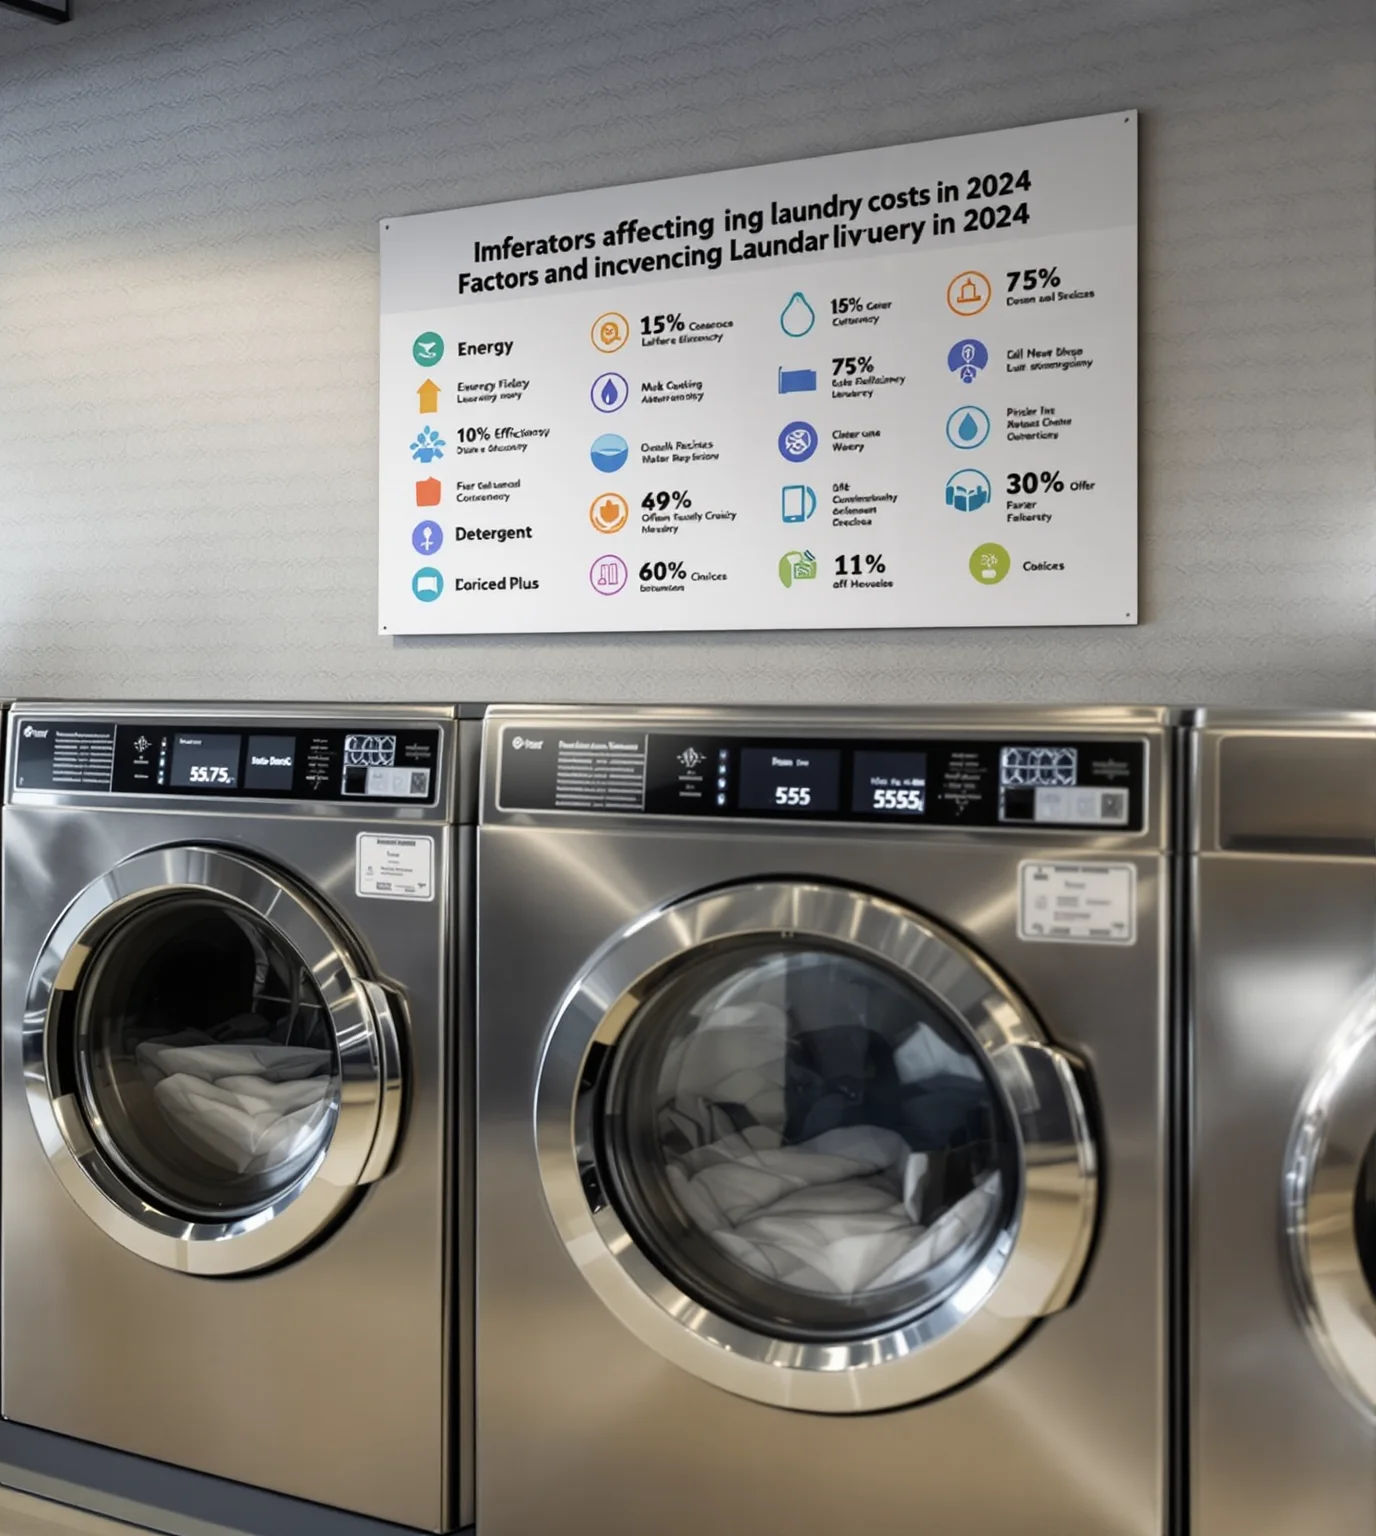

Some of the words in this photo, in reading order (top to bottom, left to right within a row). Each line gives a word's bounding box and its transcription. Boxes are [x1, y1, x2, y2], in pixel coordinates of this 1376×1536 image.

[474, 232, 595, 263] Imferators
[603, 216, 714, 247] affecting
[724, 208, 764, 234] ing
[771, 194, 863, 225] laundry
[868, 186, 930, 212] costs
[937, 181, 959, 203] in
[967, 169, 1031, 200] 2024
[458, 269, 539, 294] Factors
[544, 257, 588, 284] and
[595, 246, 722, 279] incvencing
[730, 229, 830, 262] Laundar
[933, 213, 956, 235] in
[963, 202, 1030, 232] 2024
[1006, 266, 1061, 292] 75%
[830, 297, 864, 314] 15%
[640, 313, 685, 335] 15%
[457, 341, 514, 356] Energy
[832, 356, 874, 376] 75%
[457, 427, 491, 443] 10%
[1006, 470, 1064, 495] 30%
[641, 490, 692, 511] 49%
[455, 526, 532, 542] Detergent
[639, 561, 687, 581] 60%
[835, 554, 886, 576] 11%
[510, 577, 539, 590] Plus
[775, 786, 811, 806] 555
